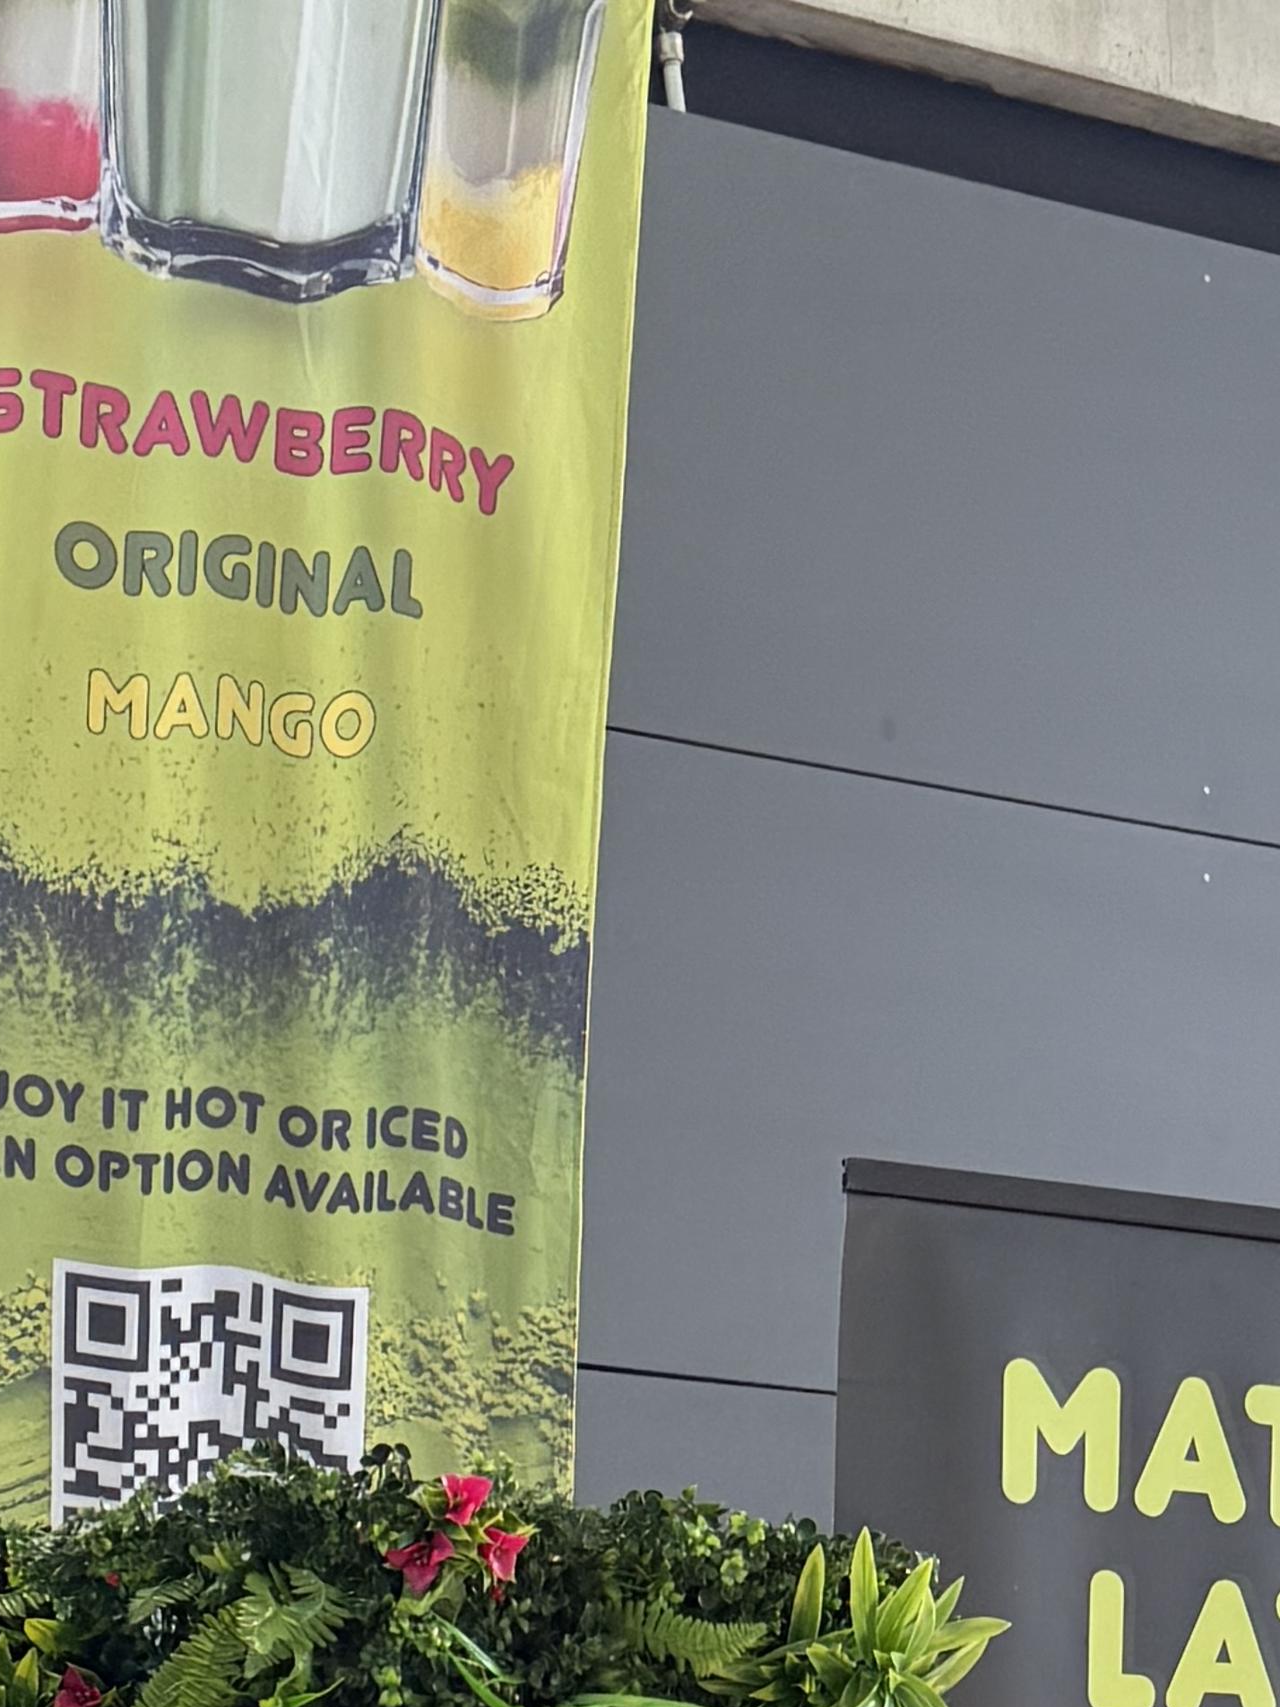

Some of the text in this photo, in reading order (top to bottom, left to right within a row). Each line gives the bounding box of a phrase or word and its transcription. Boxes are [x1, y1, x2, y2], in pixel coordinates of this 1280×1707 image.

[54, 521, 423, 618] ORIGINAL
[86, 668, 375, 758] MANGO
[102, 1087, 149, 1132] IT
[166, 1086, 265, 1134] HOT
[278, 1105, 352, 1151] OR
[366, 1105, 468, 1159] ICED
[55, 1145, 250, 1196] OPTION
[264, 1164, 516, 1236] AVAILABLE
